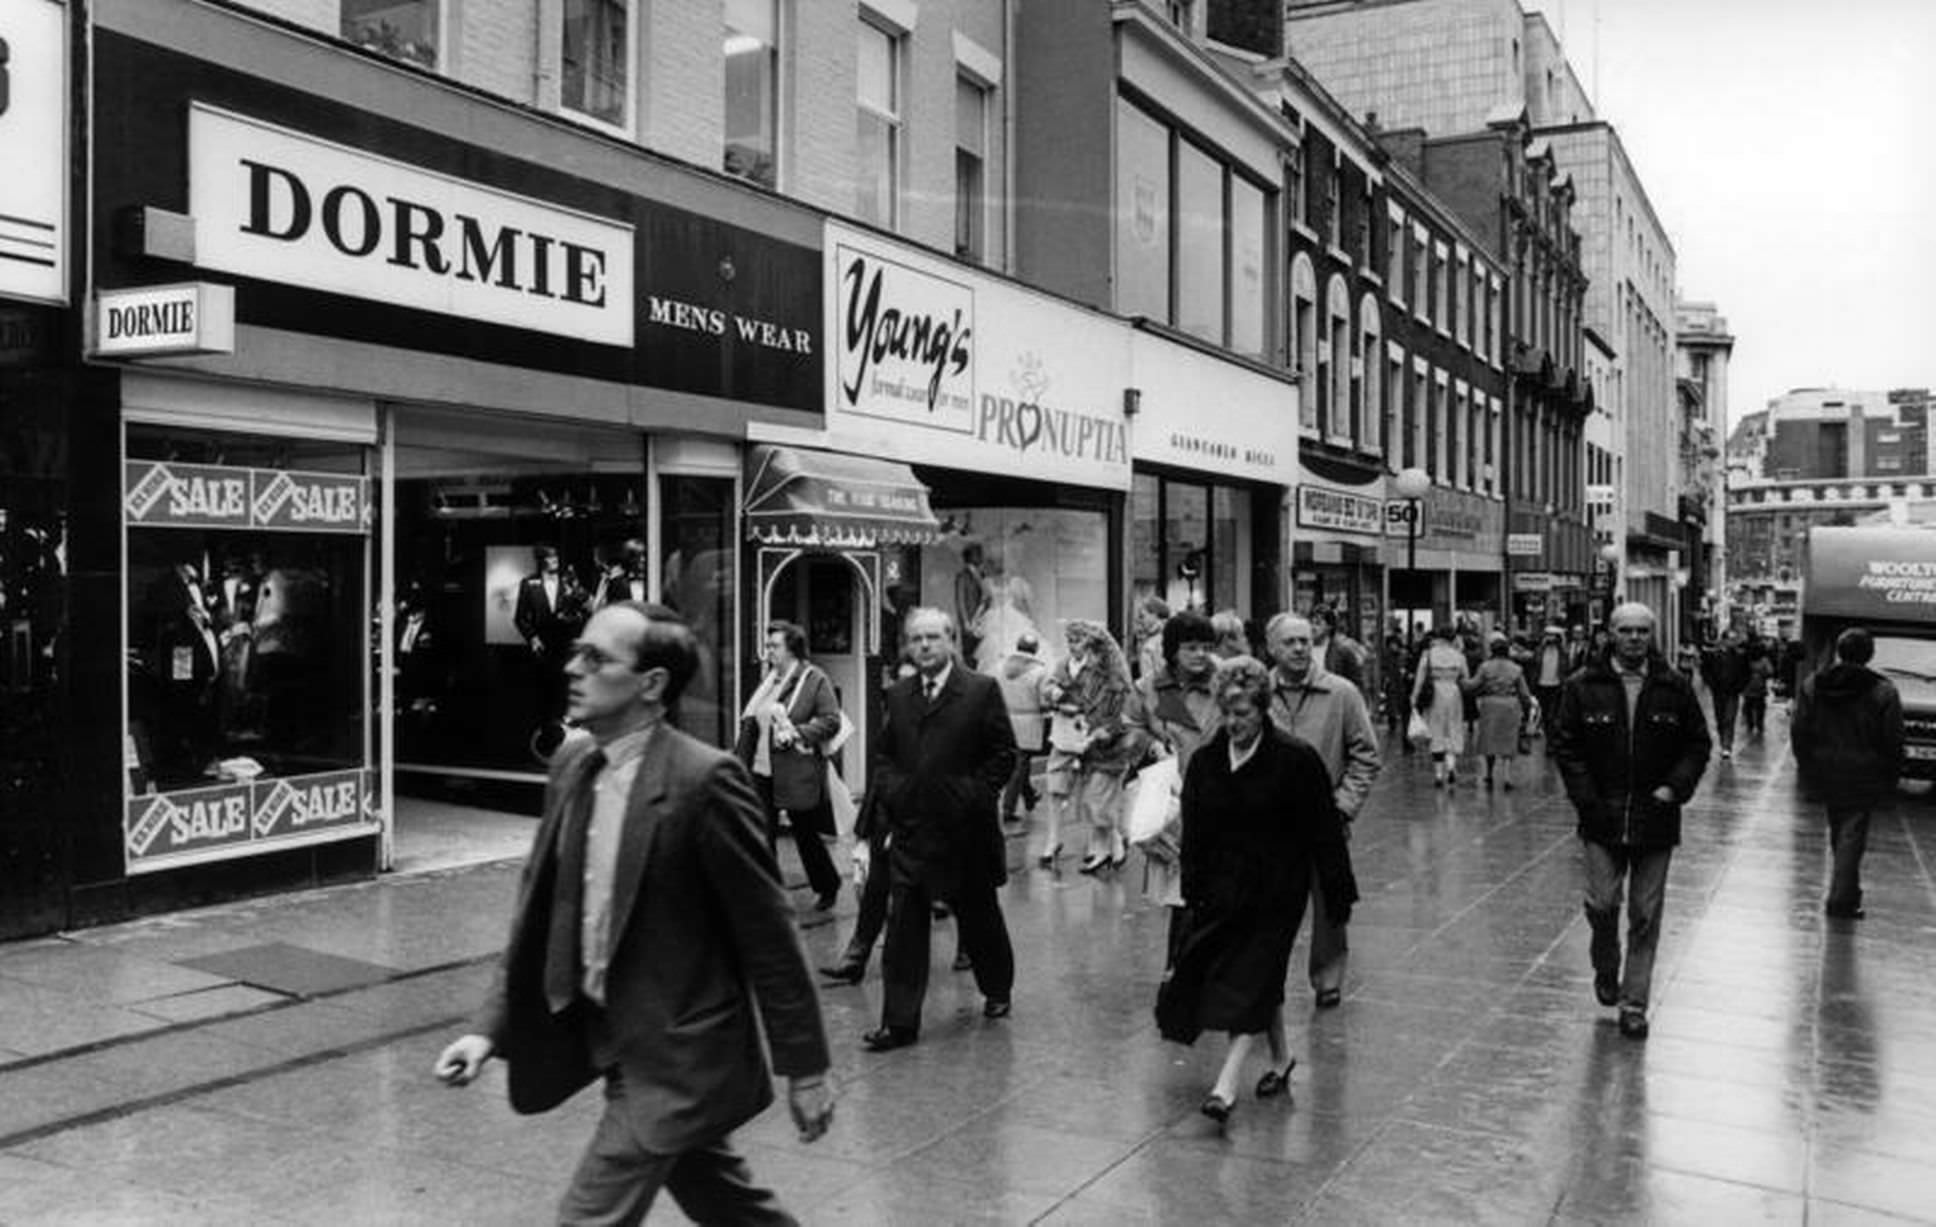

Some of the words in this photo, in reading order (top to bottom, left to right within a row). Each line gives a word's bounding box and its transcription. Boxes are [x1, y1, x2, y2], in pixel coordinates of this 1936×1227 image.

[239, 159, 606, 308] DORMIE
[108, 299, 194, 339] DORMIE
[648, 295, 726, 335] MENS
[734, 315, 812, 354] WEAR
[843, 257, 971, 412] Young's
[978, 393, 1128, 465] PRONUPTIA
[169, 476, 245, 517] SALE
[291, 484, 356, 523] SALE
[170, 795, 246, 846] SALE
[291, 780, 356, 826] SALE
